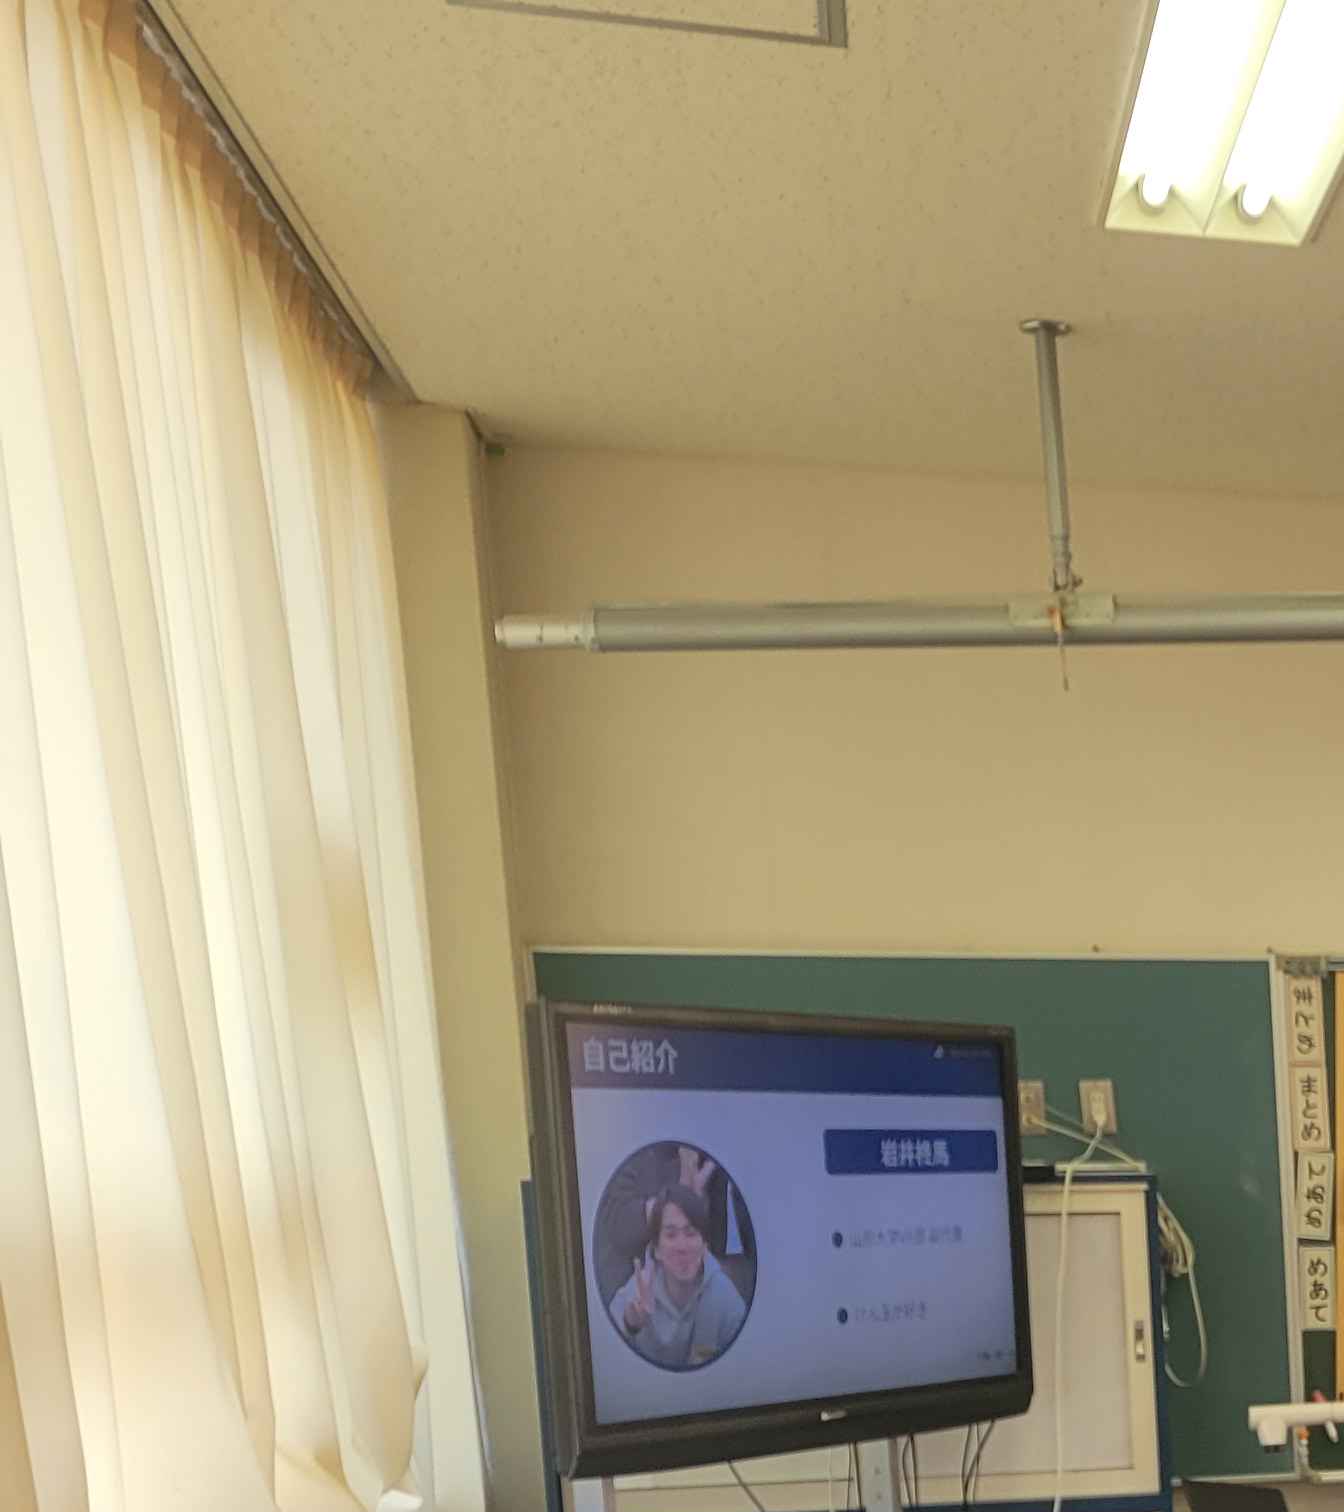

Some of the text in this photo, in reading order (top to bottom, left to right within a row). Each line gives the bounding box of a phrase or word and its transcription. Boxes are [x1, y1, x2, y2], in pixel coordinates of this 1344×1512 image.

[1293, 985, 1316, 1055] まとめ
[583, 1035, 679, 1075] 自己紹介
[1299, 1074, 1322, 1142] まとめ
[1304, 1162, 1328, 1230] めあて
[1306, 1257, 1329, 1322] めあて
